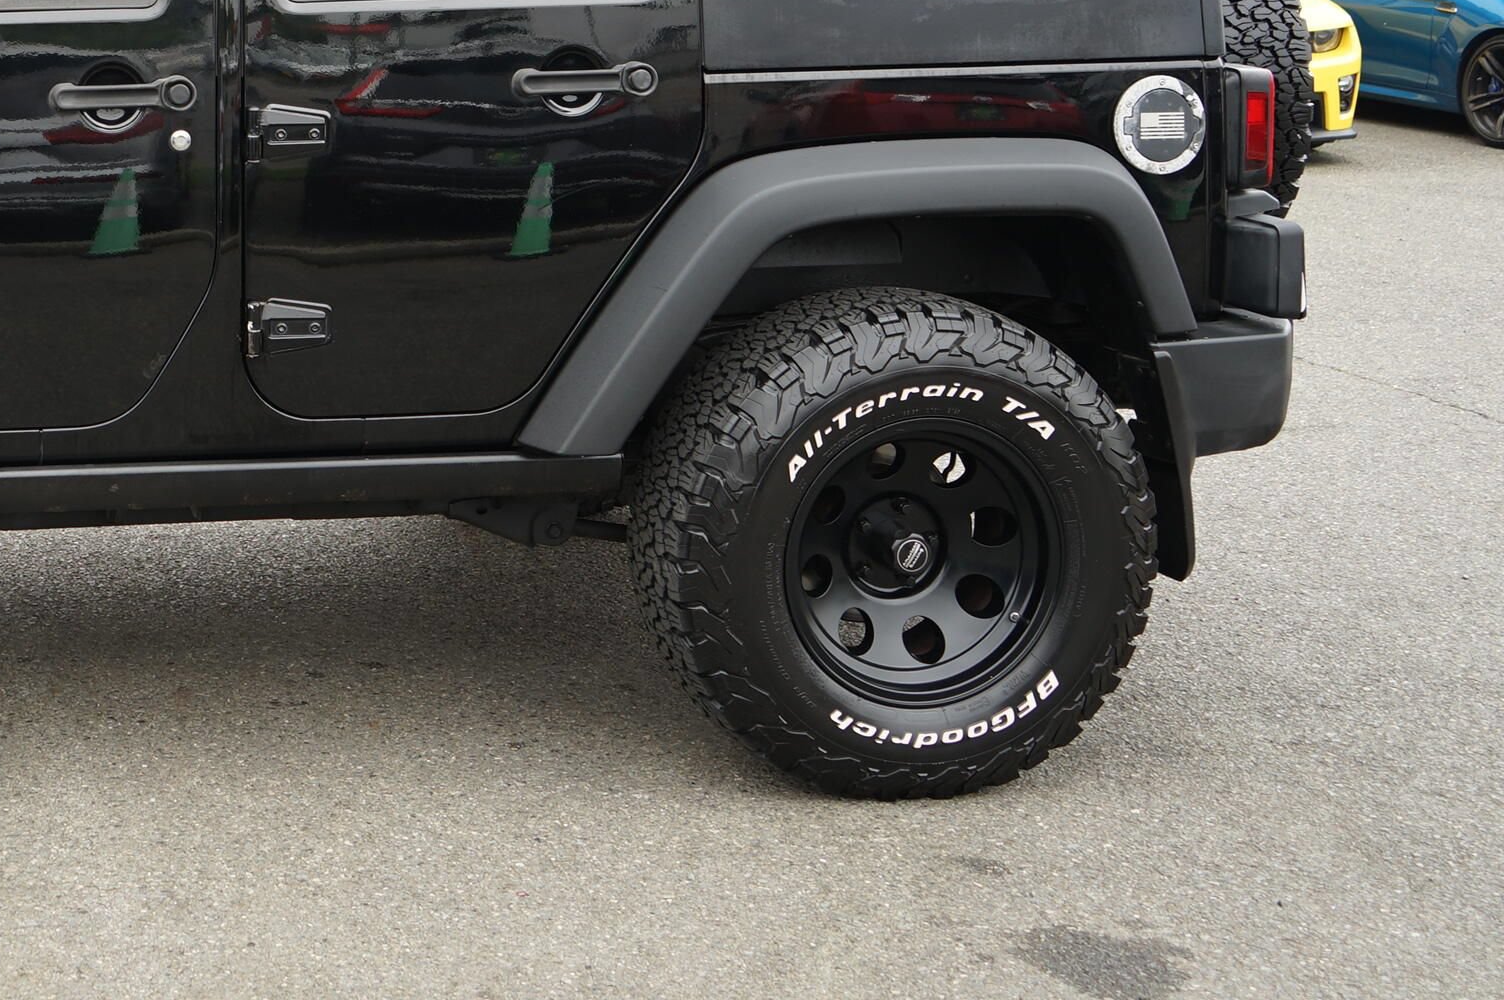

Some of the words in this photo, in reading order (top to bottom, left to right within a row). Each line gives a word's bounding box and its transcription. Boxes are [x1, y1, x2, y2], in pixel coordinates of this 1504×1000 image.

[787, 382, 984, 483] All-Terrain
[1001, 396, 1056, 441] T/A
[828, 669, 1060, 748] BFGoodrich
